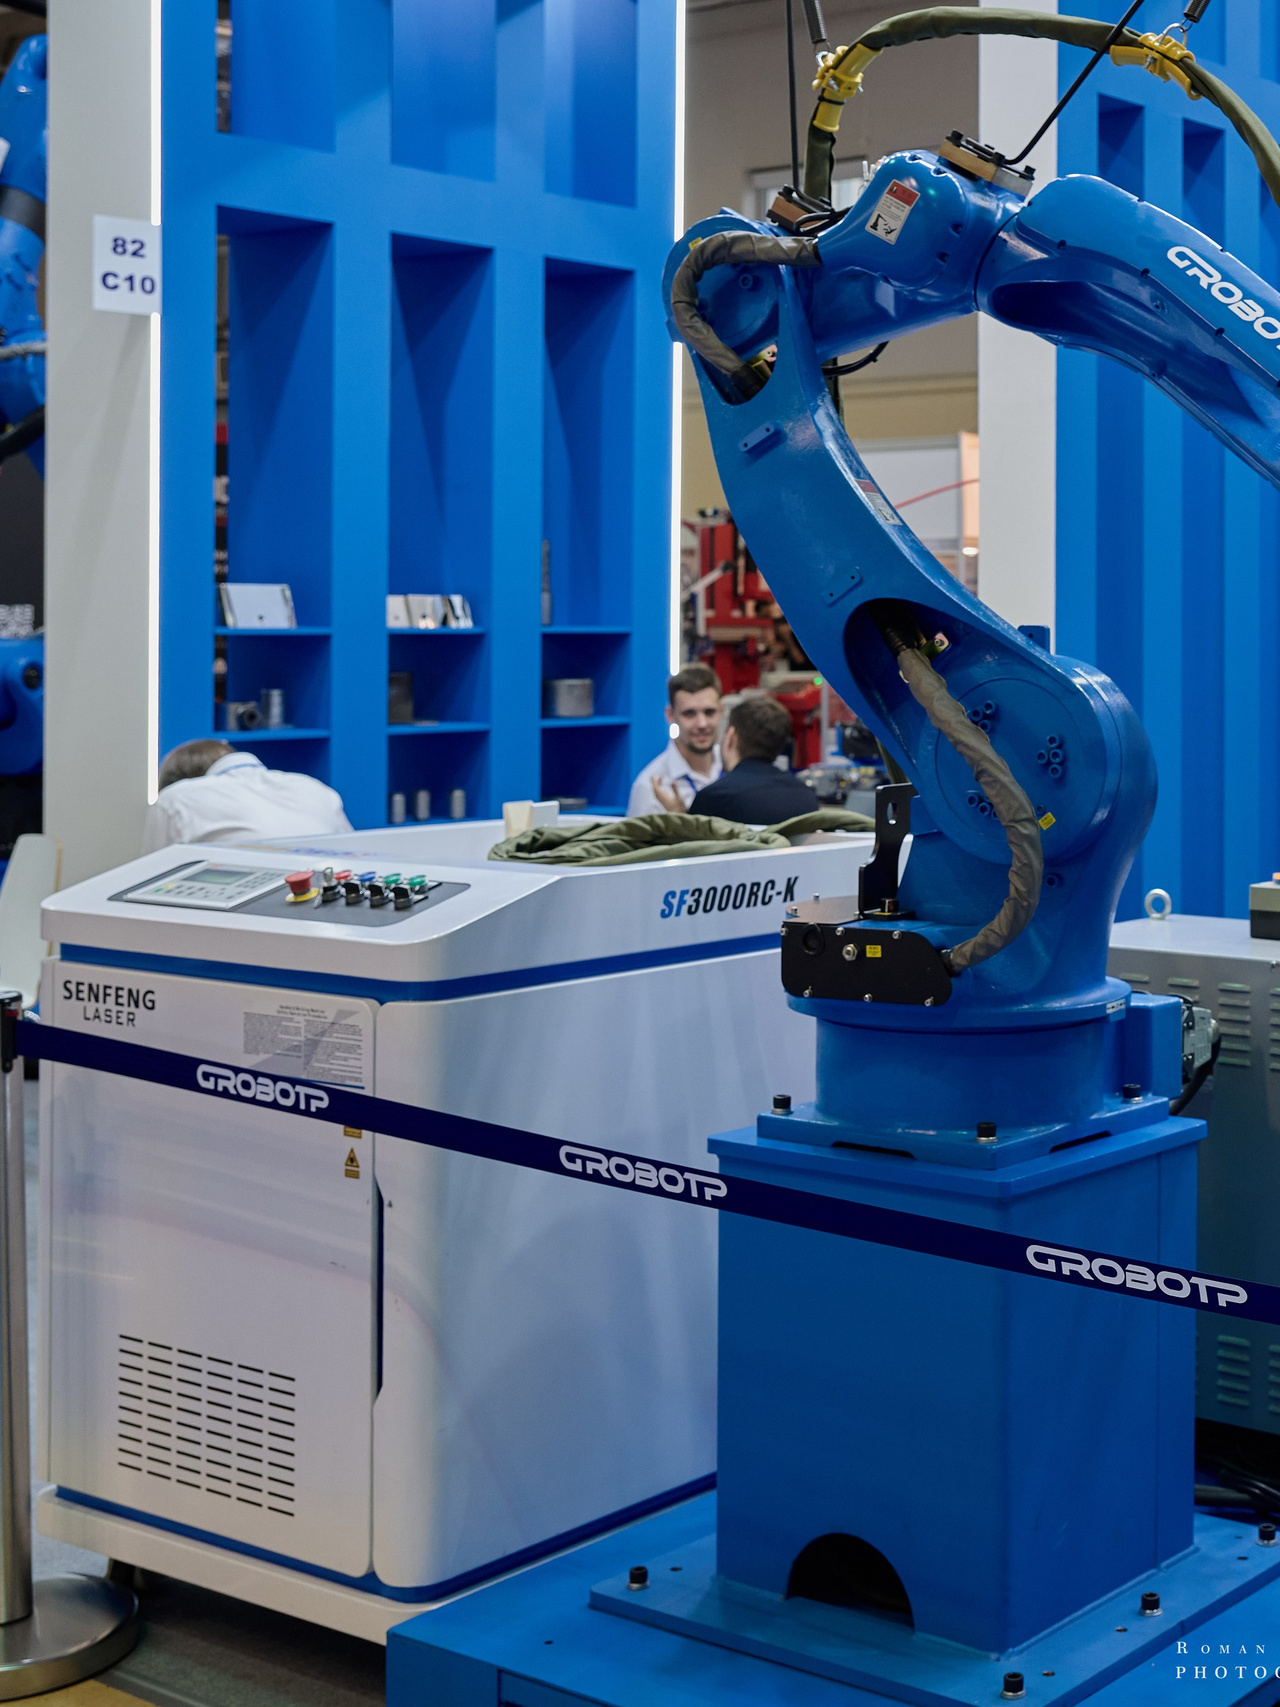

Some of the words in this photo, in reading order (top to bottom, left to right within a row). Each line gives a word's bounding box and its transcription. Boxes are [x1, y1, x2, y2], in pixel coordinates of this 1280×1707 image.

[111, 236, 147, 258] 82
[101, 271, 156, 295] C10
[660, 875, 799, 919] SF3000RC-K
[62, 980, 156, 1011] SENFENG
[83, 1005, 137, 1028] LASER
[196, 1064, 330, 1112] GROBOTP
[559, 1145, 728, 1201] GROBOTP
[1026, 1244, 1249, 1307] GROBOTP
